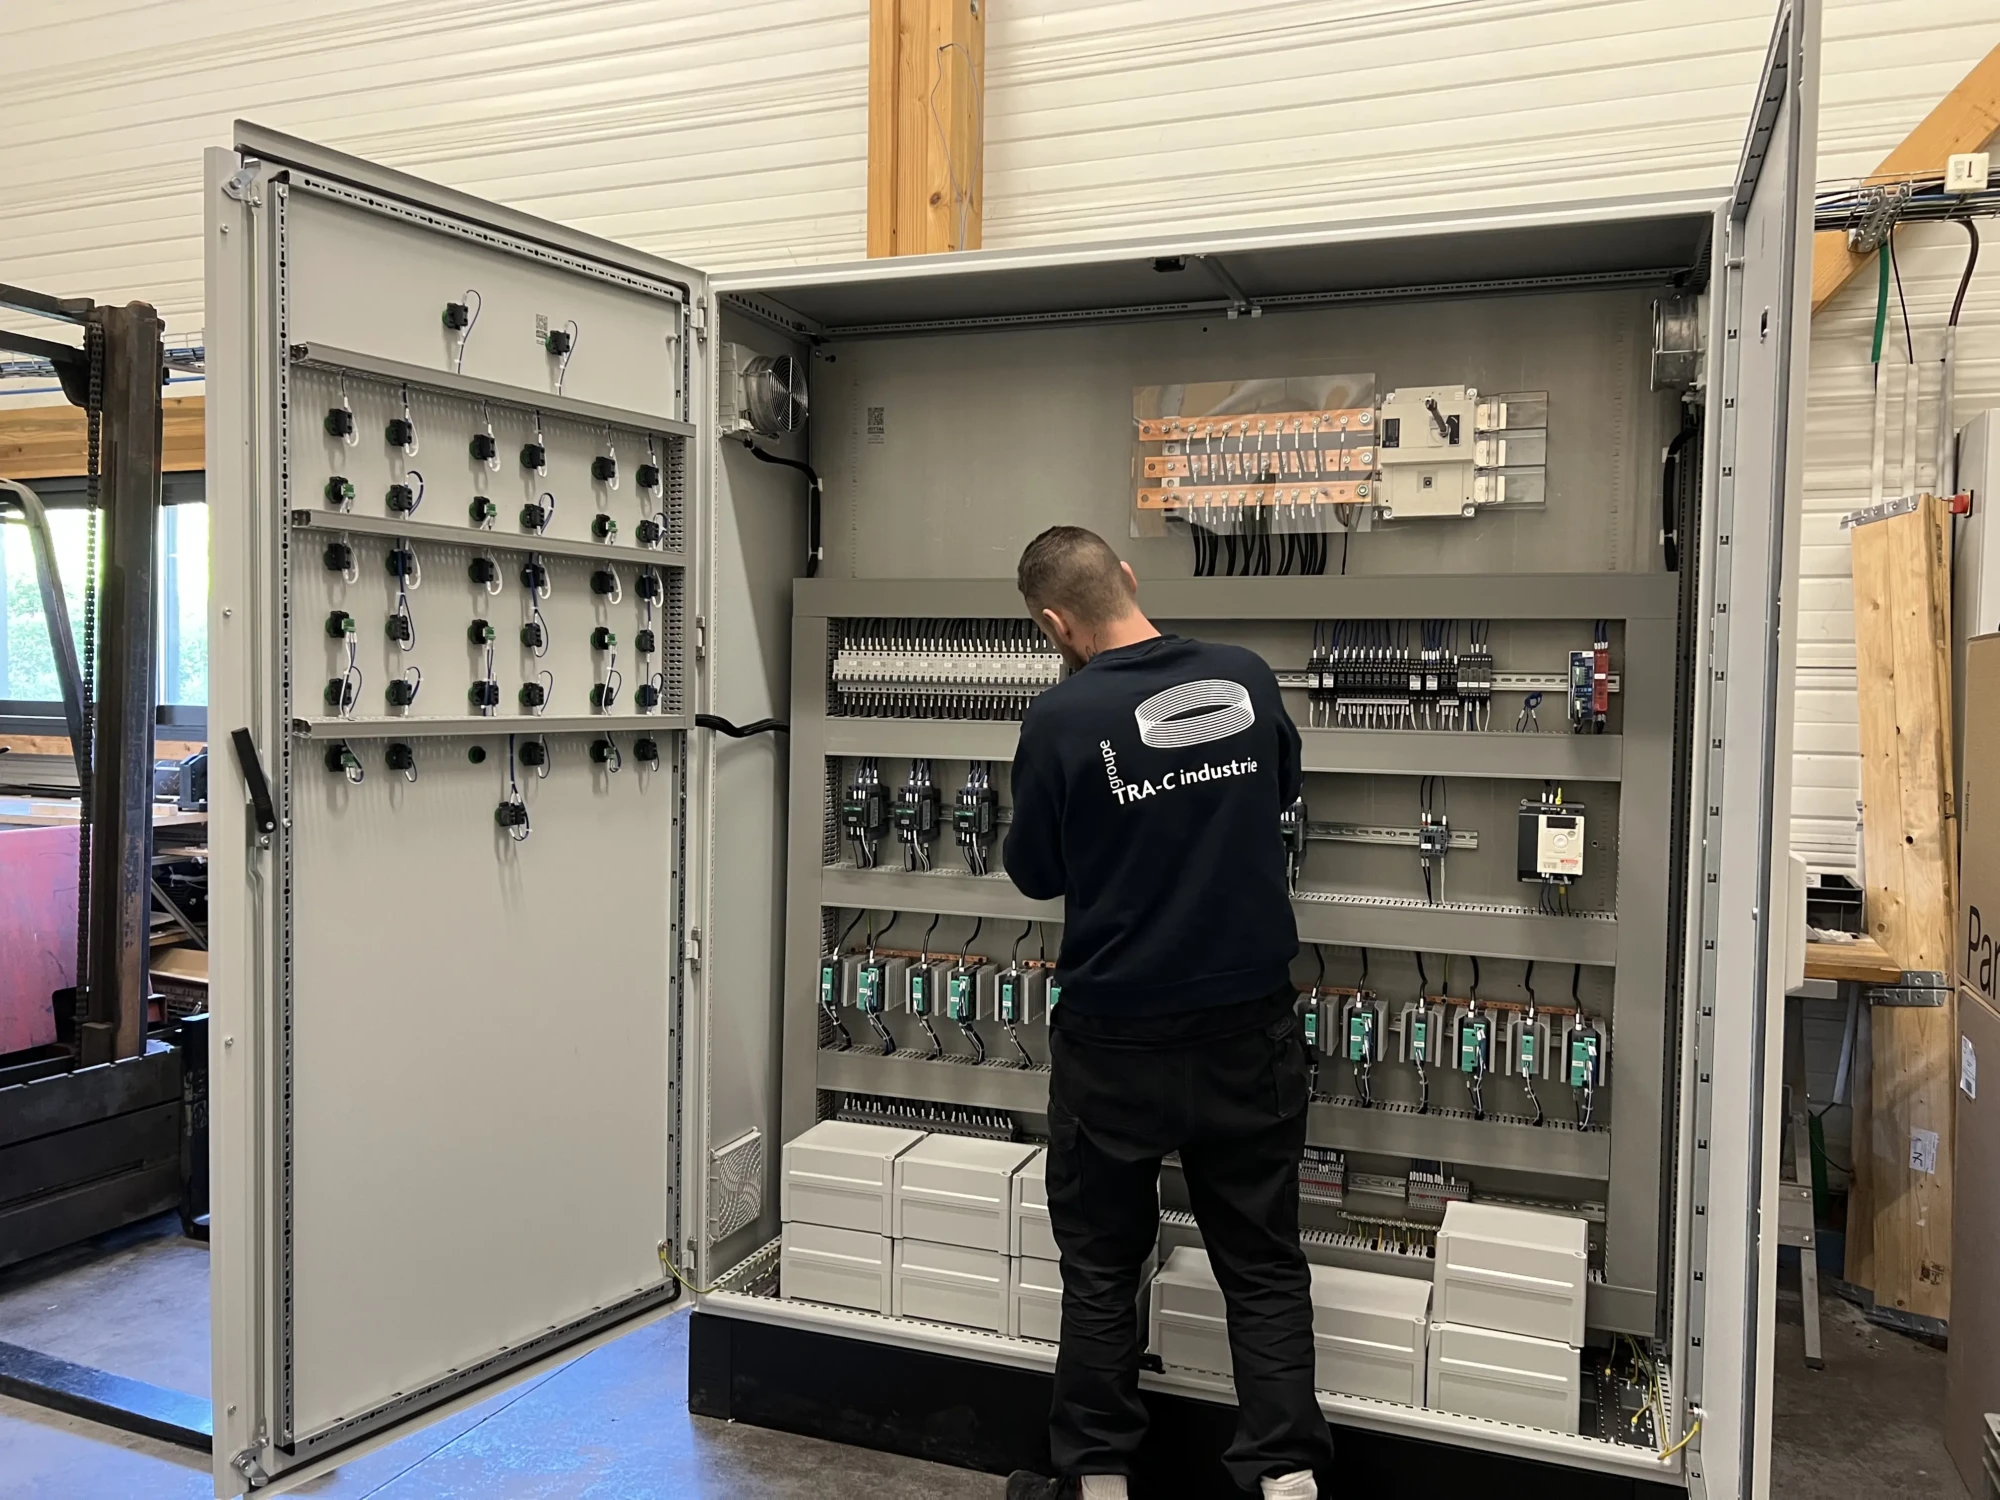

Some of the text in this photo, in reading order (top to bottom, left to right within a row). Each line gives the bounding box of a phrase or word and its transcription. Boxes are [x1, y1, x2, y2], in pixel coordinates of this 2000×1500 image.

[1100, 739, 1123, 790] groupe
[1112, 757, 1258, 805] TRA-C industrie
